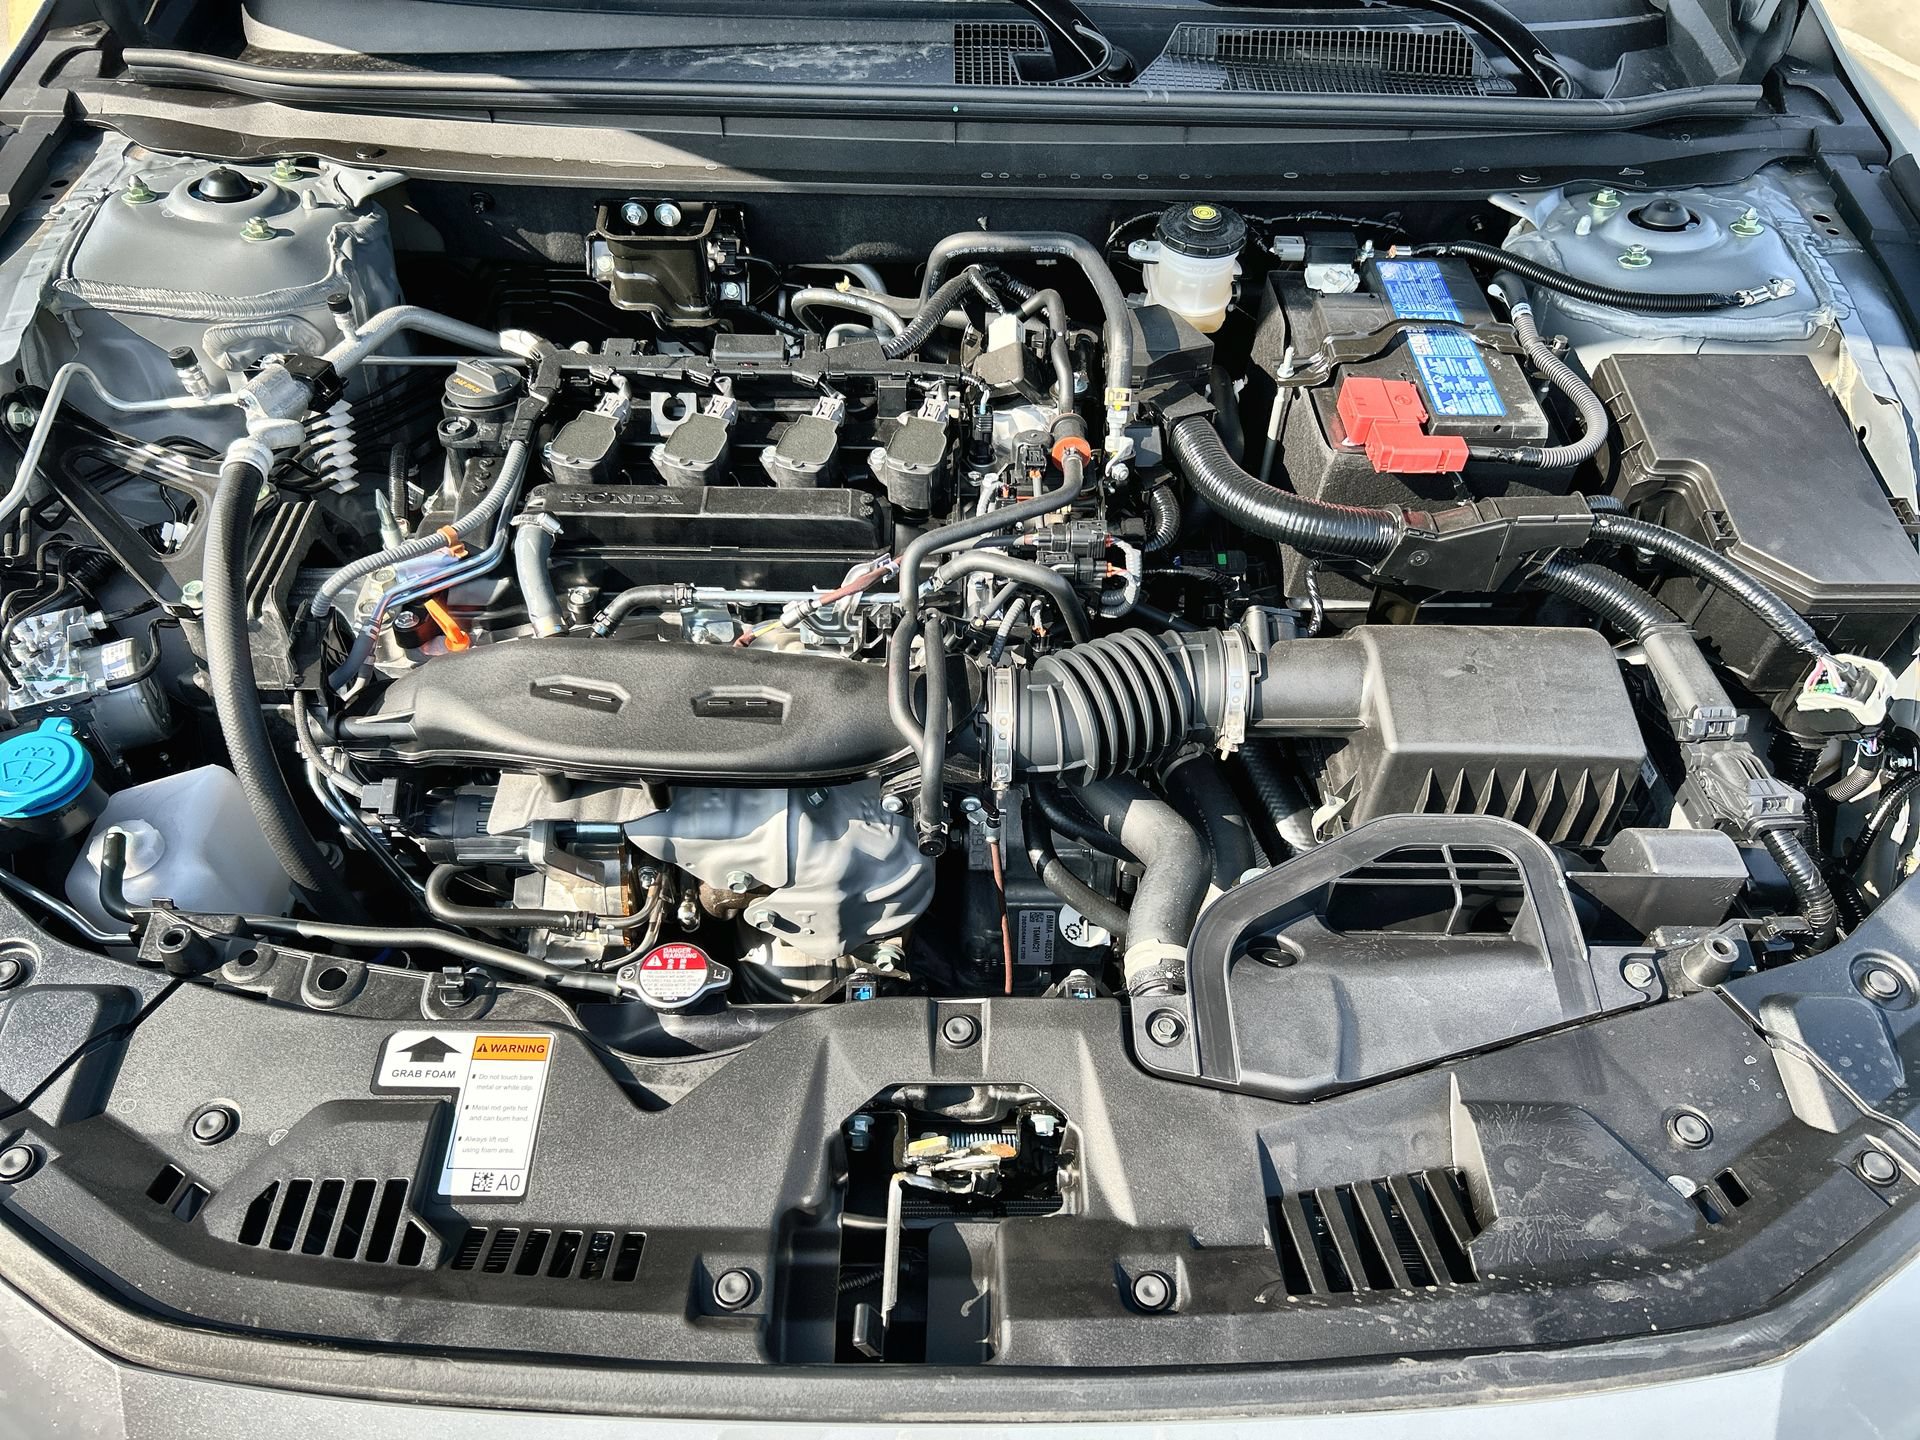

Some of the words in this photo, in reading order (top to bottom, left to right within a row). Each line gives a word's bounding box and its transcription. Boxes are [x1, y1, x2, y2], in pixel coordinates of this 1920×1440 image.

[560, 492, 684, 505] HONDA
[490, 1044, 545, 1054] WARNING
[391, 1069, 422, 1078] GRAB
[425, 1070, 456, 1079] FOAM
[496, 1174, 521, 1191] A0
